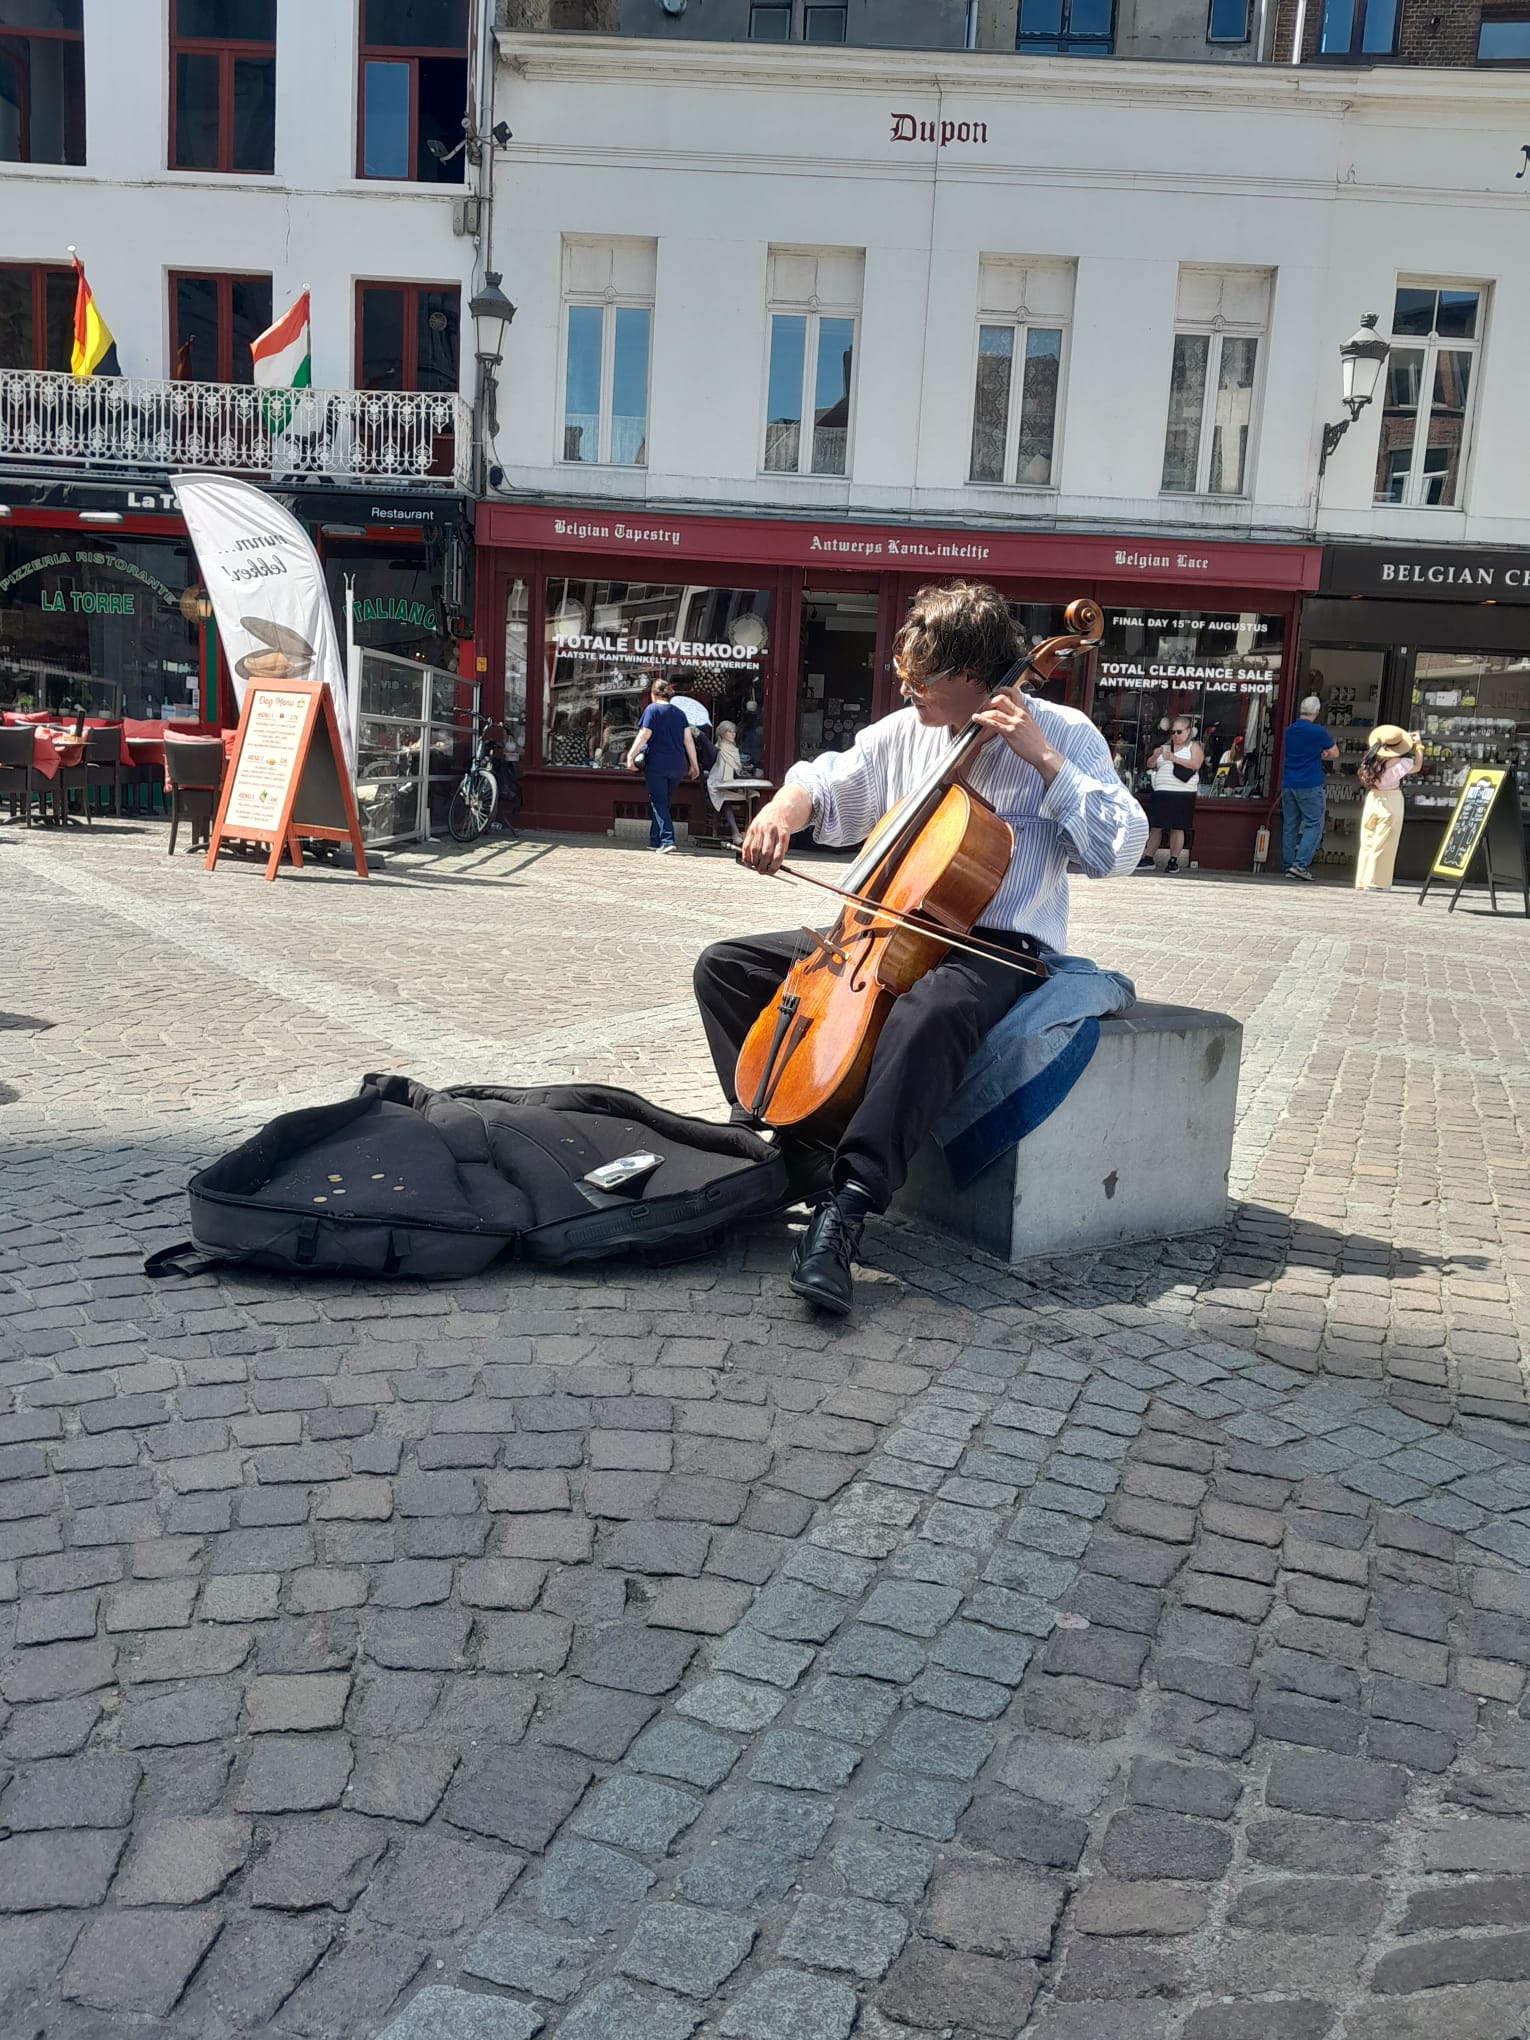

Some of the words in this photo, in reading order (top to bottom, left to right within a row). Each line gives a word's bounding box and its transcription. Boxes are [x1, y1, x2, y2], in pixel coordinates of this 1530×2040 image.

[889, 112, 988, 147] Dupon
[127, 491, 156, 509] La
[371, 507, 434, 520] Restaurant
[554, 519, 609, 538] Belgian
[614, 524, 680, 545] Tapestry
[810, 535, 882, 556] Antwerps
[1114, 550, 1170, 569] Belgian
[1176, 554, 1209, 569] Lace
[0, 551, 71, 592] PIZZERIA
[75, 551, 178, 605] RISTORANTE
[1381, 563, 1495, 585] BELGIAN
[41, 590, 65, 612] LA
[70, 591, 135, 615] TORRE
[1112, 616, 1144, 627] FINAL
[1147, 618, 1169, 628] DAY
[1191, 620, 1206, 630] OF
[1208, 621, 1268, 633] AUGUSTUS
[556, 634, 628, 652] TOTALE
[634, 638, 758, 660] UITVERKOOP
[555, 650, 597, 660] LAATSTE
[599, 653, 678, 666] KANTWINKELTJE
[680, 657, 700, 668] VAN
[701, 659, 760, 670] ANTWERPEN
[1101, 662, 1145, 675] TOTAL
[1149, 665, 1233, 679] CLEARANCE
[1237, 669, 1274, 681] SALE
[1099, 677, 1169, 689] ANTWERP'S
[1172, 680, 1203, 691] LAST
[1206, 682, 1237, 692] LACE
[1240, 683, 1273, 694] SHOP
